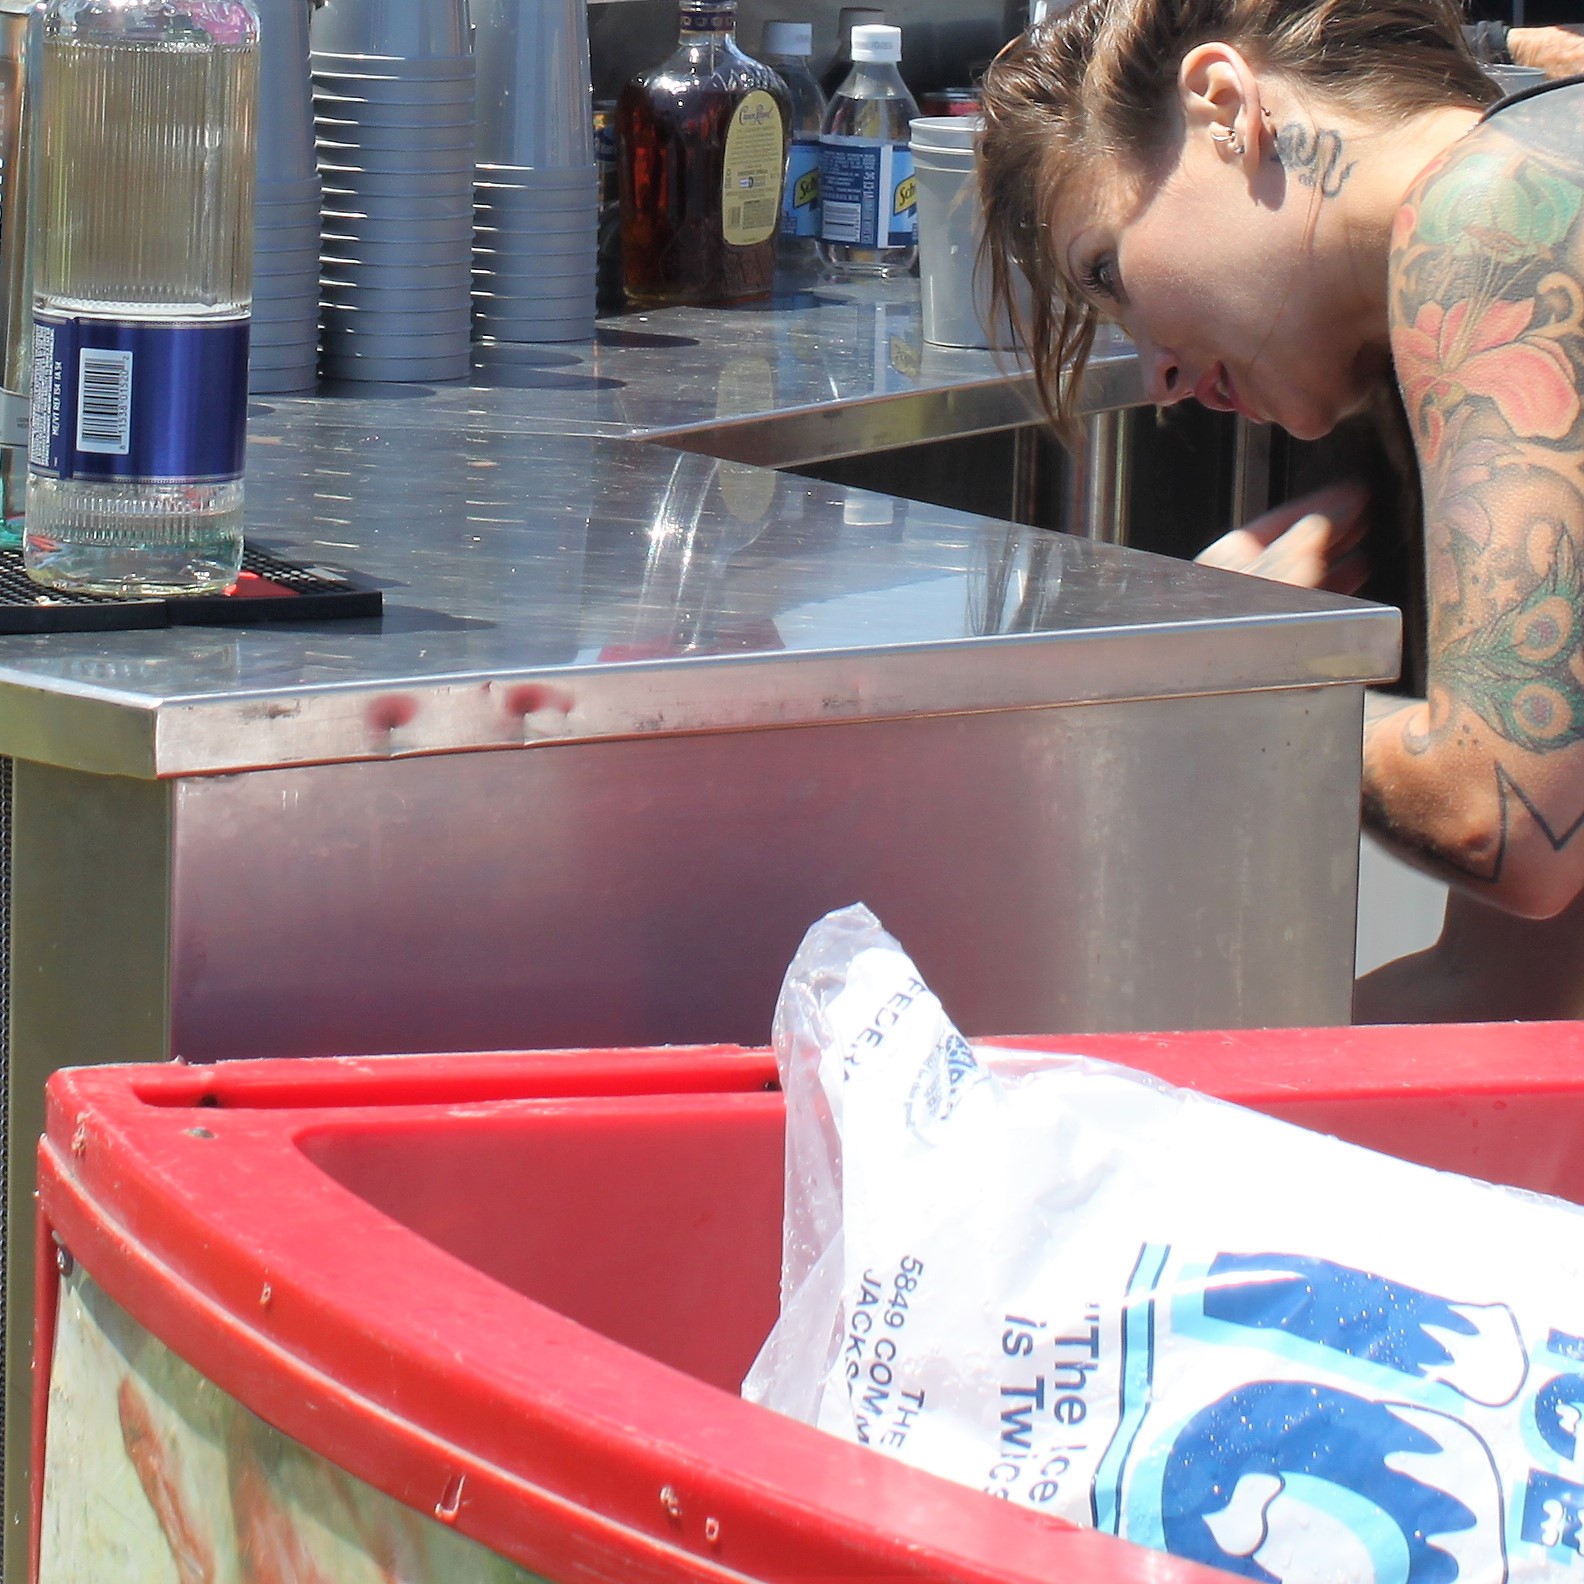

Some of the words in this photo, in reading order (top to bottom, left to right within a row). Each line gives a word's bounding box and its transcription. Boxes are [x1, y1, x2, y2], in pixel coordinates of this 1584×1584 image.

[119, 369, 129, 401] 01520
[118, 404, 128, 434] 11538
[883, 1254, 924, 1329] 5849
[1000, 1313, 1049, 1359] is
[879, 1388, 926, 1449] THE
[1029, 1443, 1089, 1505] Ice
